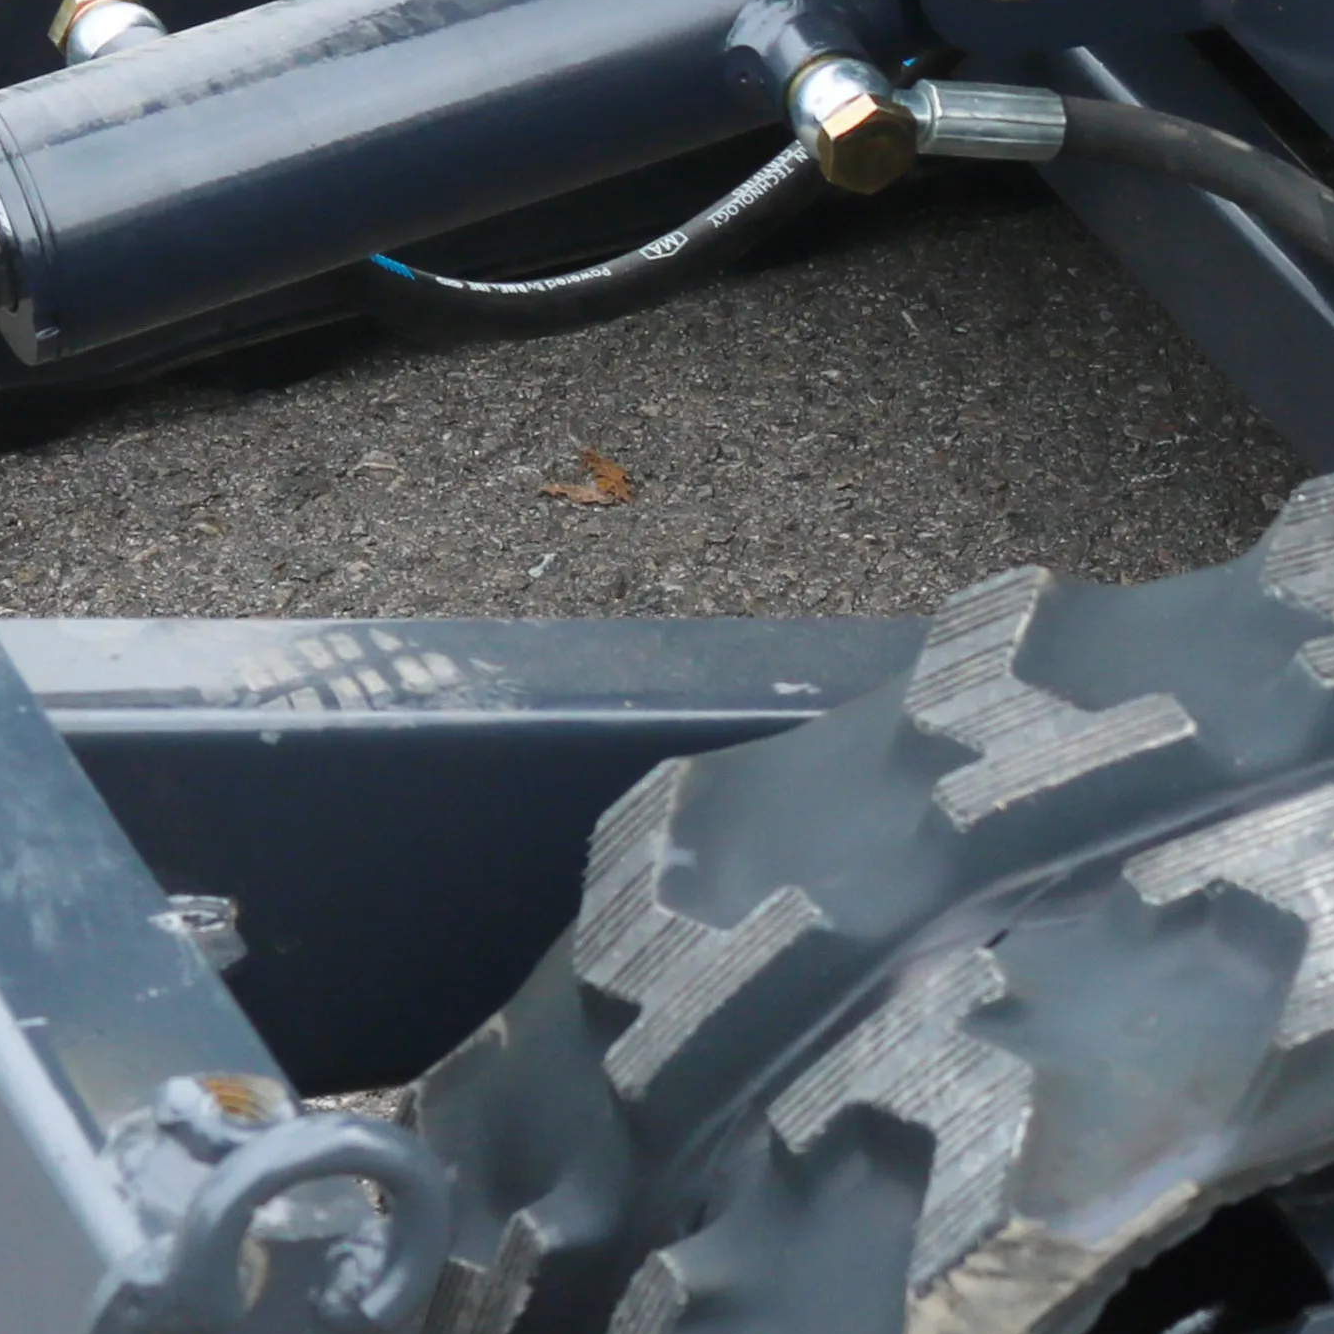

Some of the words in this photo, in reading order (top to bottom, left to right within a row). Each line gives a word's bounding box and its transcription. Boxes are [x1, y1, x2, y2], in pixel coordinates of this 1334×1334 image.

[710, 162, 795, 229] TECHNOLOGY
[651, 235, 680, 255] MA
[547, 267, 612, 291] Powered
